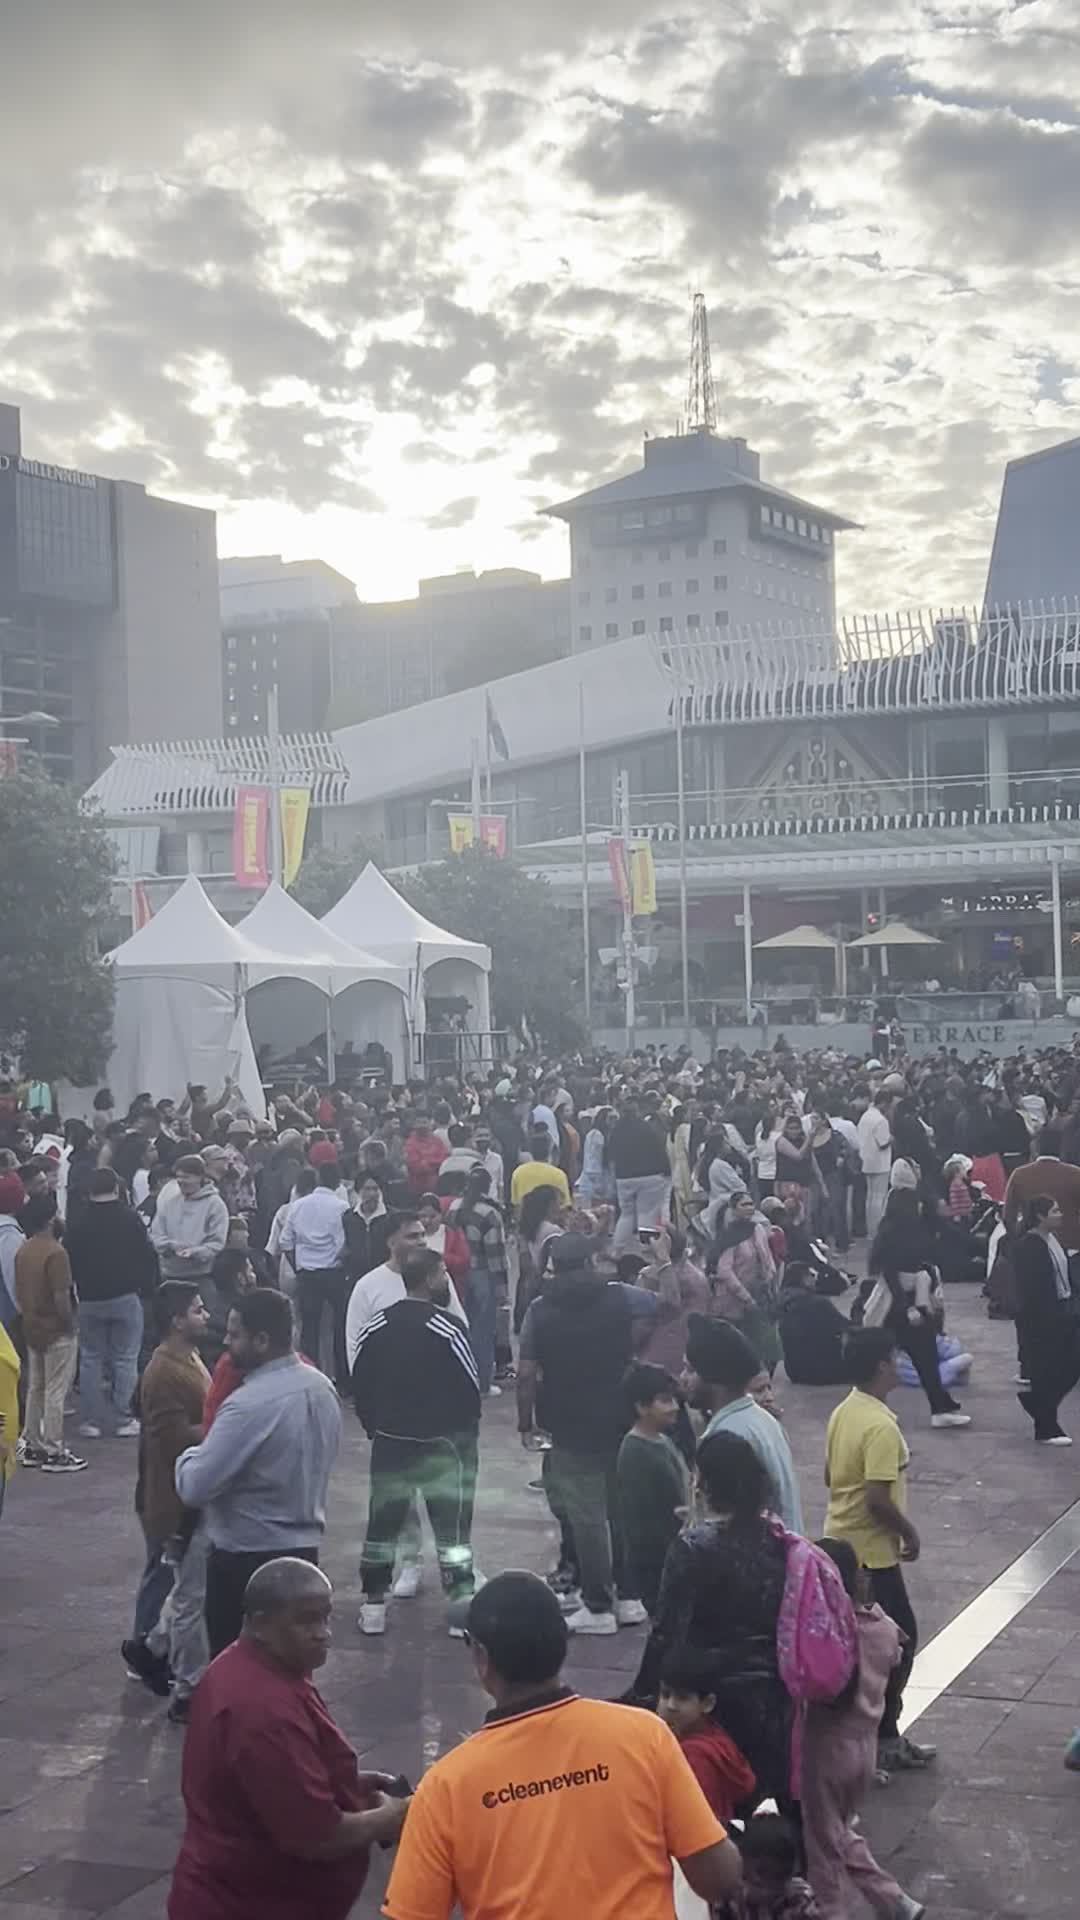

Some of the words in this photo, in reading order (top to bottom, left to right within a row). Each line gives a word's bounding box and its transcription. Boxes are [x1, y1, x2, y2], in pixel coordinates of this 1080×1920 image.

[18, 458, 97, 489] MILLENNIUM
[902, 1025, 1005, 1044] ERRACE
[498, 1763, 609, 1804] cleanevent
